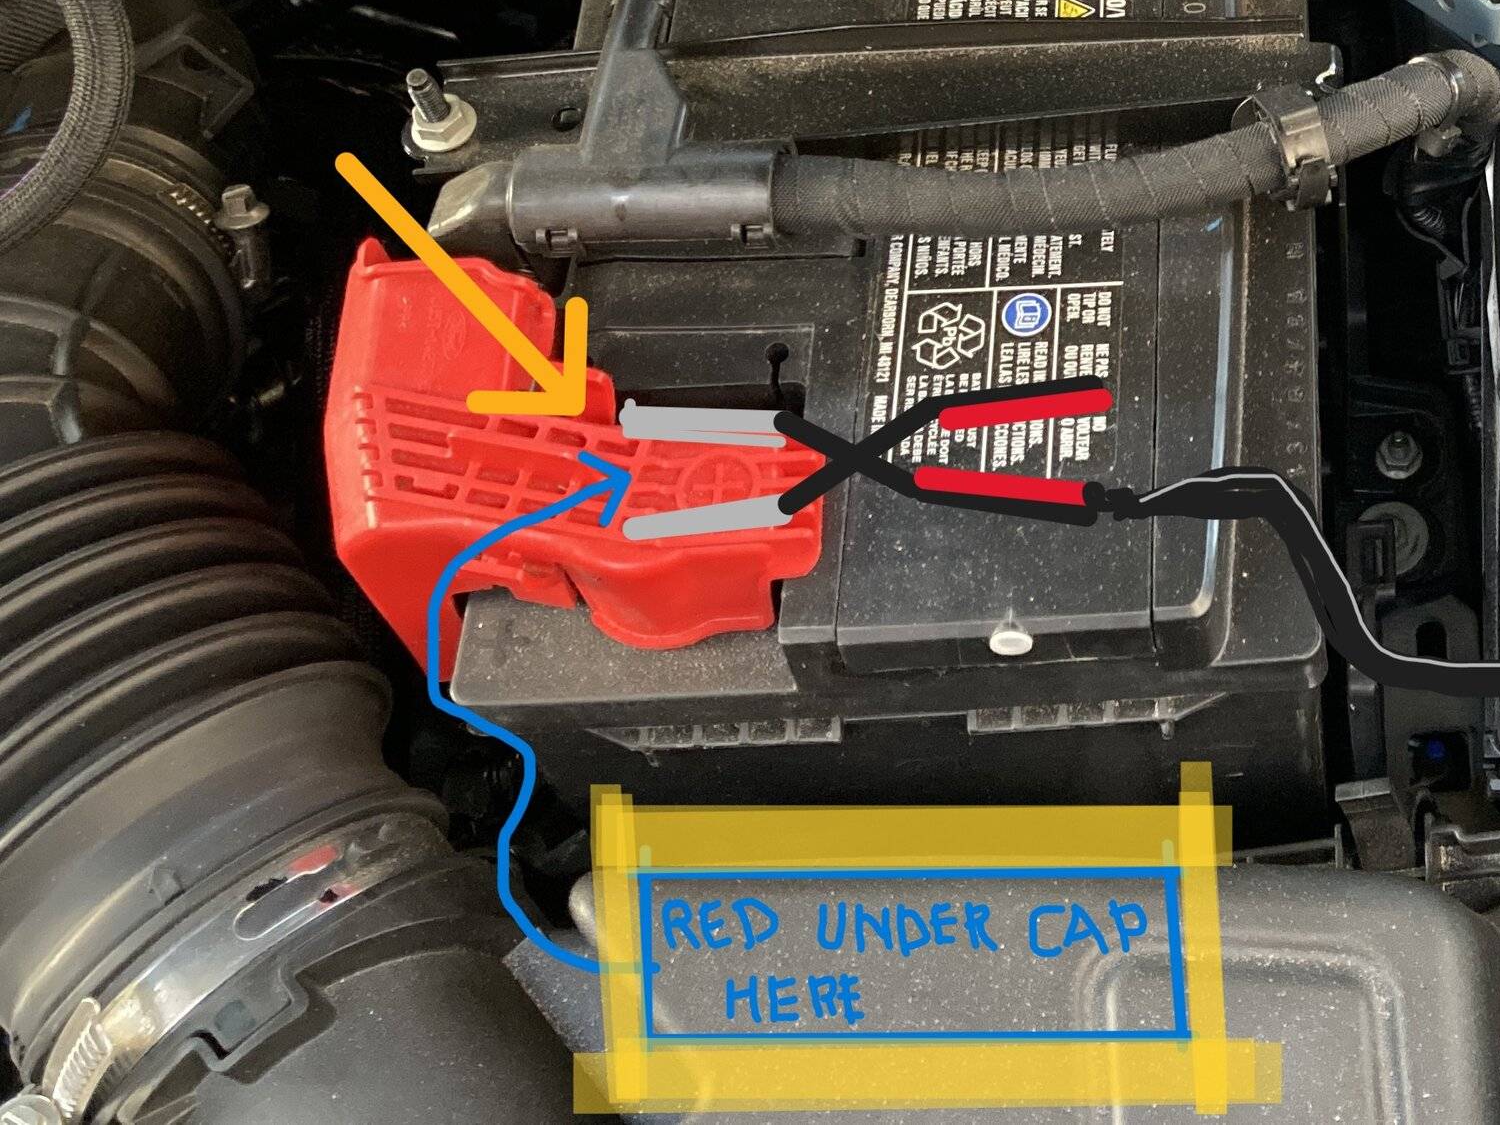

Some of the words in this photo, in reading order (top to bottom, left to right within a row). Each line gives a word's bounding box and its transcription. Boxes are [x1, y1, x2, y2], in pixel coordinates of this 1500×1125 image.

[1066, 293, 1081, 322] OPEN.
[1083, 292, 1096, 307] TIP
[1097, 291, 1112, 305] DO
[1081, 309, 1095, 324] OR
[1097, 307, 1111, 326] NOT
[942, 327, 958, 347] Pb
[1000, 342, 1014, 362] LEA
[1017, 342, 1031, 365] LIRE
[1034, 341, 1048, 368] READ
[1064, 346, 1079, 358] OU
[1095, 344, 1109, 357] NE
[998, 364, 1013, 384] LAS
[1015, 366, 1029, 385] LES
[1095, 358, 1109, 378] PAS
[906, 376, 915, 395] SER
[944, 374, 954, 387] LA
[1093, 416, 1106, 432] NO
[1075, 417, 1090, 460] VOLTEAR
[938, 439, 949, 464] DOIT
